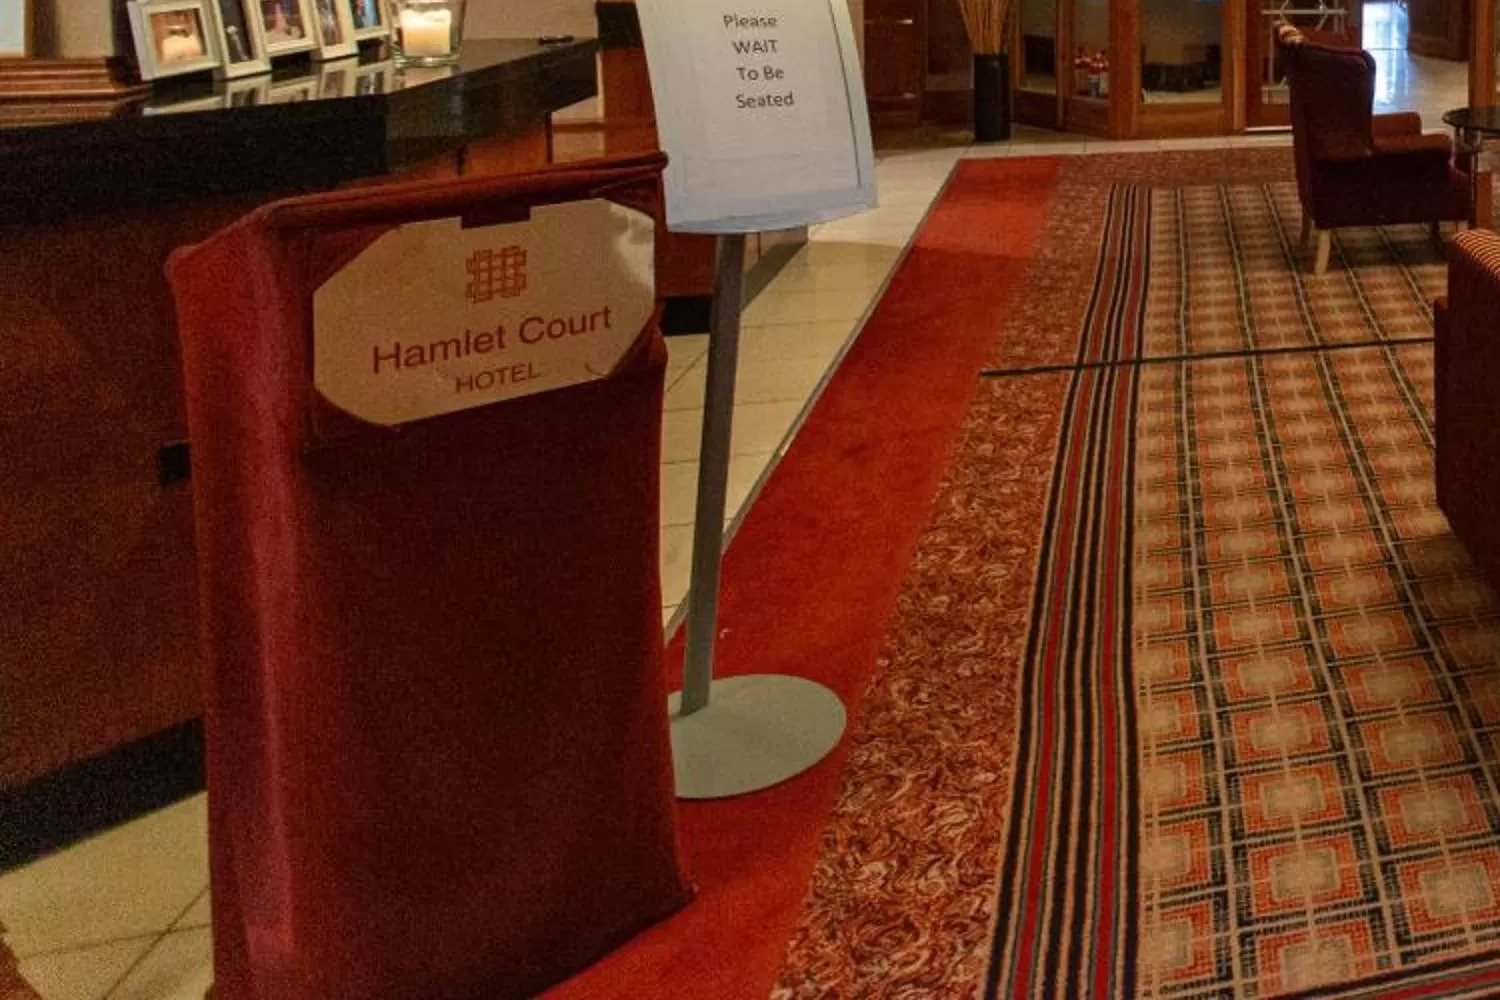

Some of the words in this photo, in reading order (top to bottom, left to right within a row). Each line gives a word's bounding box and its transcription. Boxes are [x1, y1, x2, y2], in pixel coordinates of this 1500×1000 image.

[723, 13, 777, 28] Please
[733, 39, 778, 54] WAIT
[736, 66, 759, 81] To
[764, 66, 784, 80] Be
[735, 91, 794, 109] Seated
[373, 325, 505, 373] Hamlet
[519, 305, 612, 344] Court
[456, 362, 541, 393] HOTEL
